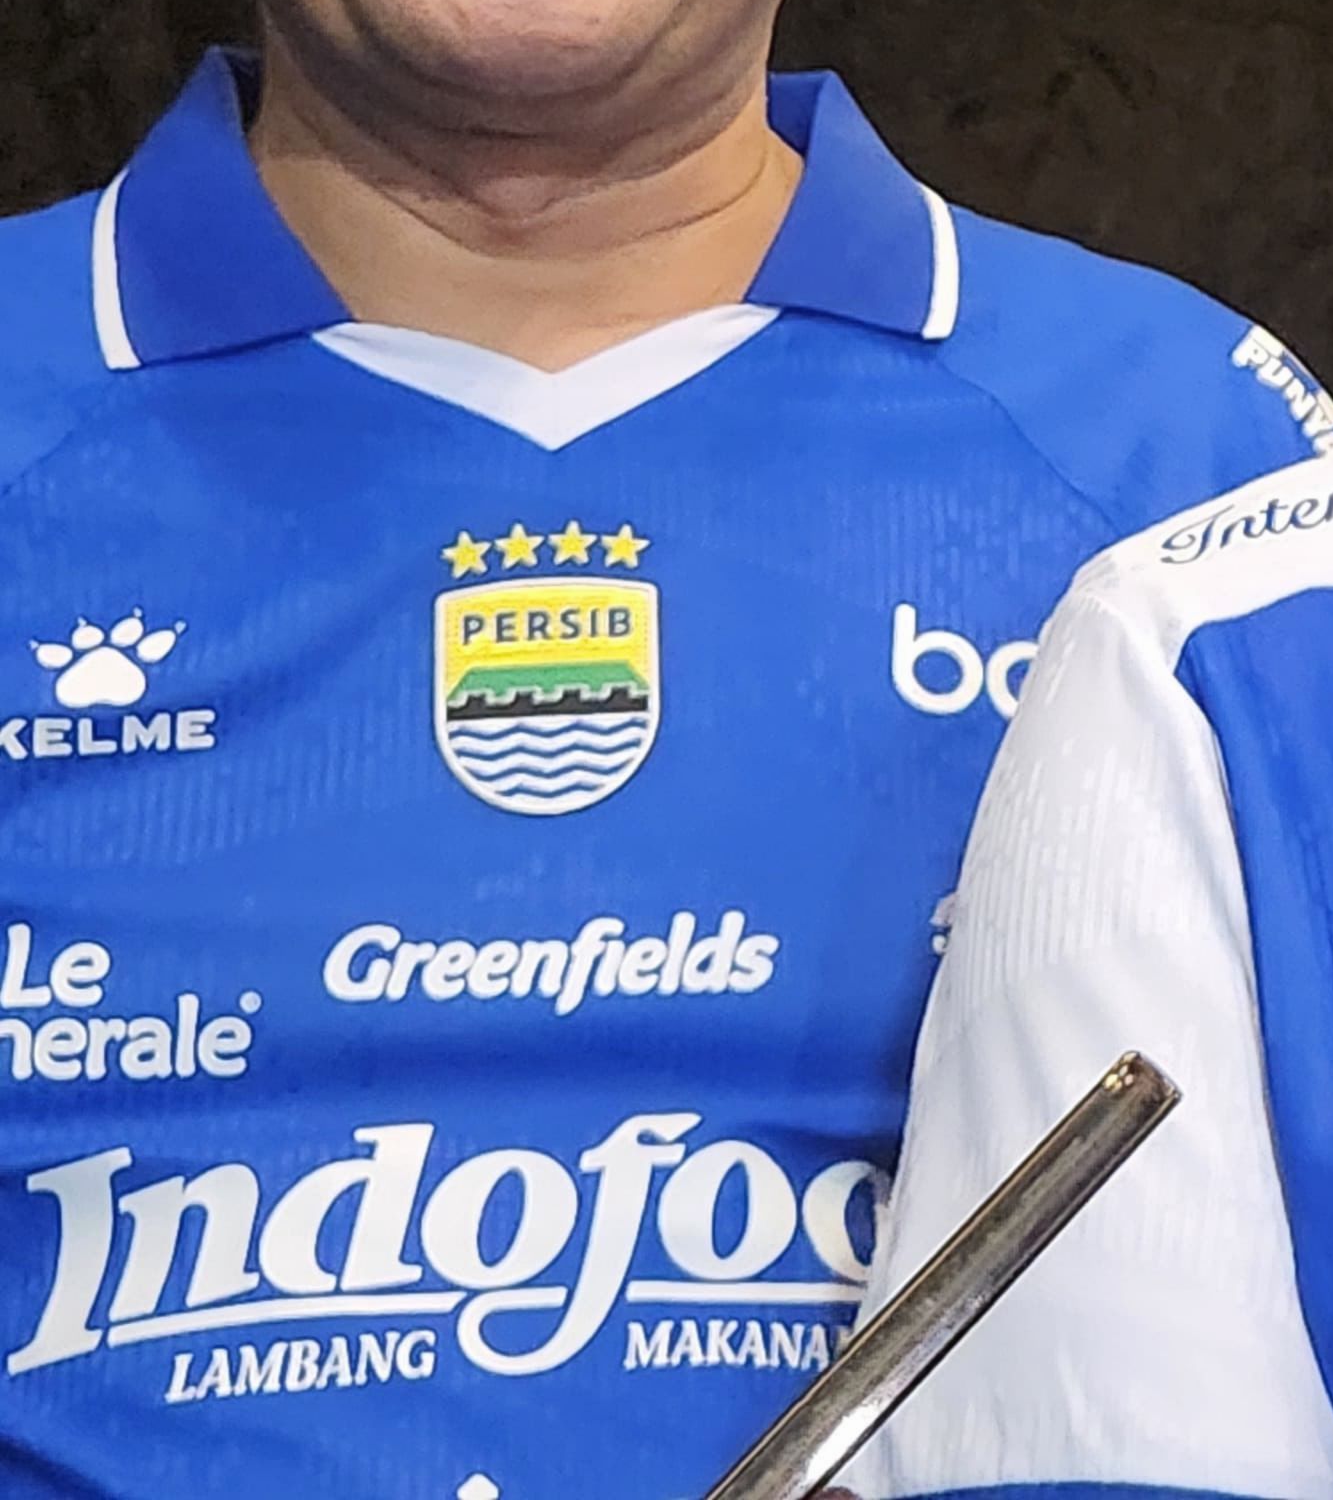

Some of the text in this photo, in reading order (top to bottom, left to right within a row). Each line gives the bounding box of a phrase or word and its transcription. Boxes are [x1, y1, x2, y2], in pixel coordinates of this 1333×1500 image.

[461, 606, 634, 646] PERSIB
[0, 709, 216, 761] KELME
[0, 922, 112, 1009] Le
[322, 910, 780, 1016] Greenfields
[0, 992, 253, 1082] nerale
[8, 1112, 895, 1377] Indofoo
[164, 1317, 850, 1406] LAMBANG MAKANA
